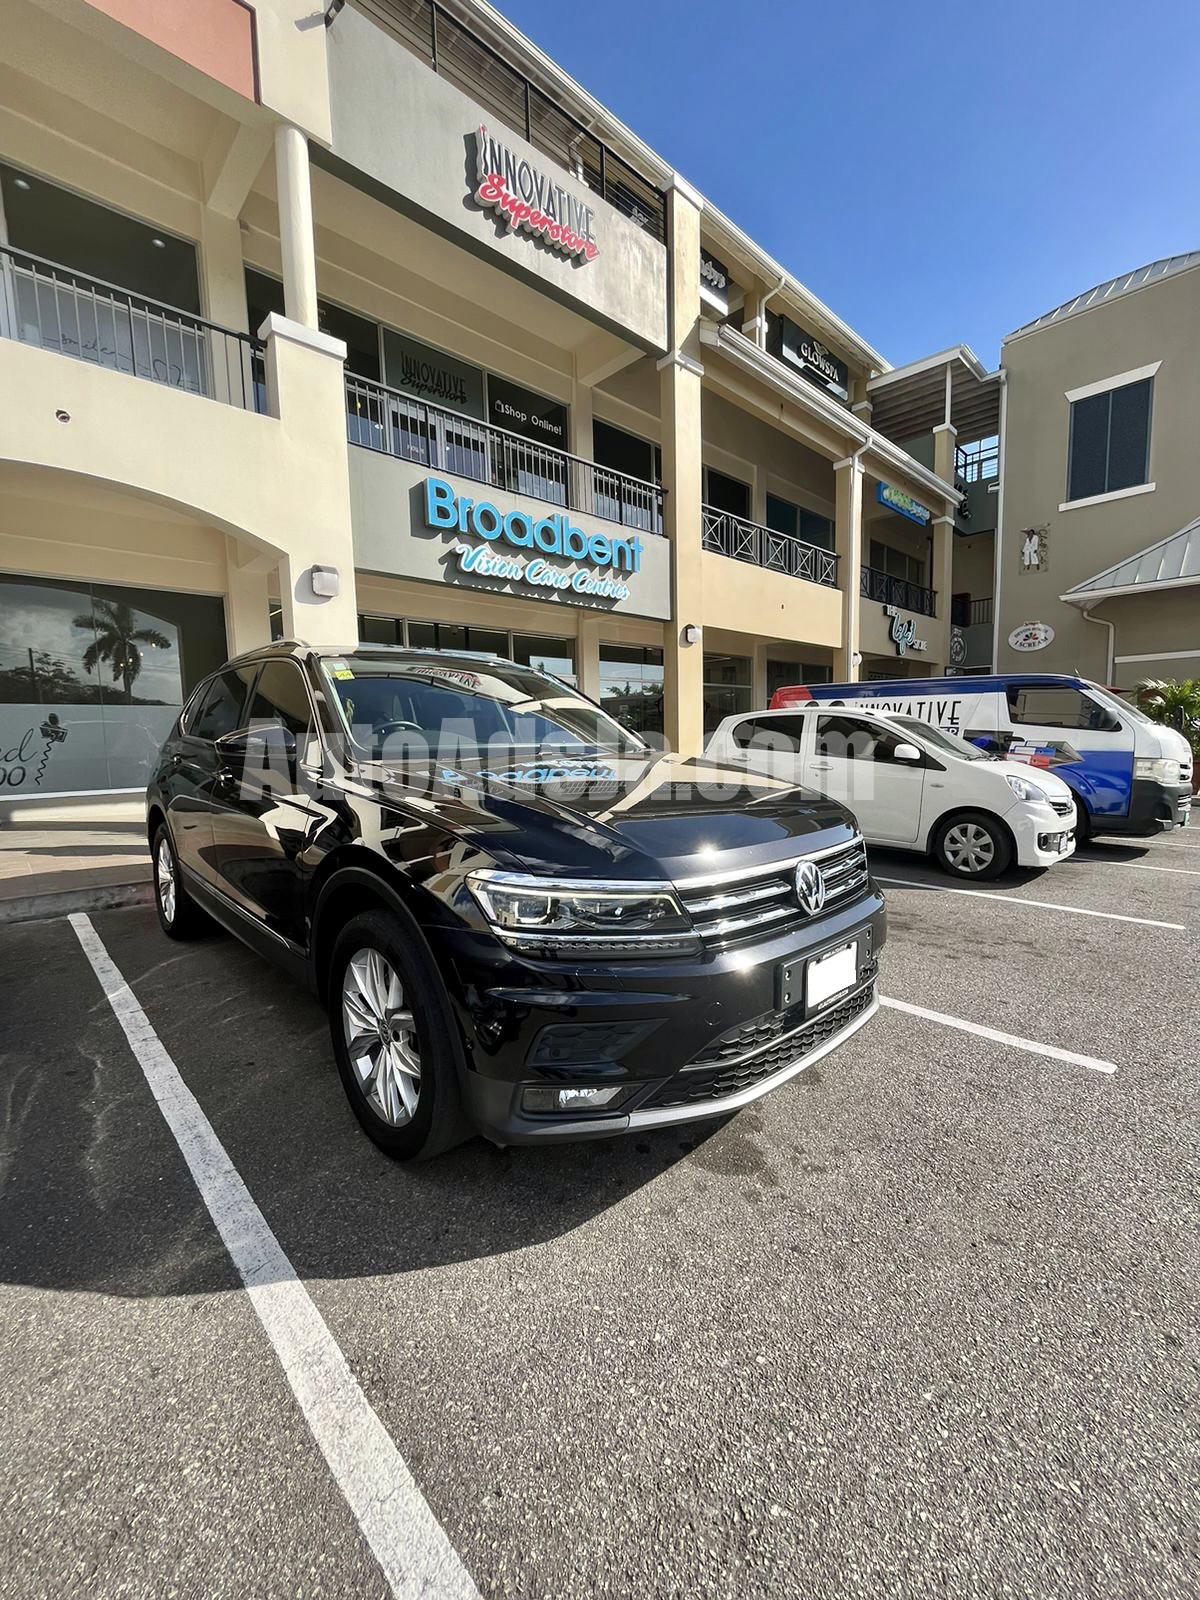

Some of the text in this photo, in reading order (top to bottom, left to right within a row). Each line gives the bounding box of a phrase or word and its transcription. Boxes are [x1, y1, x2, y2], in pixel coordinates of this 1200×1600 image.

[479, 173, 600, 261] Superstore
[480, 123, 596, 243] INNOVATIVE
[400, 351, 466, 393] INNOVATIVE
[504, 404, 563, 436] Shop Online!
[426, 476, 644, 573] Broadbent
[456, 543, 631, 601] Vision Care Centres
